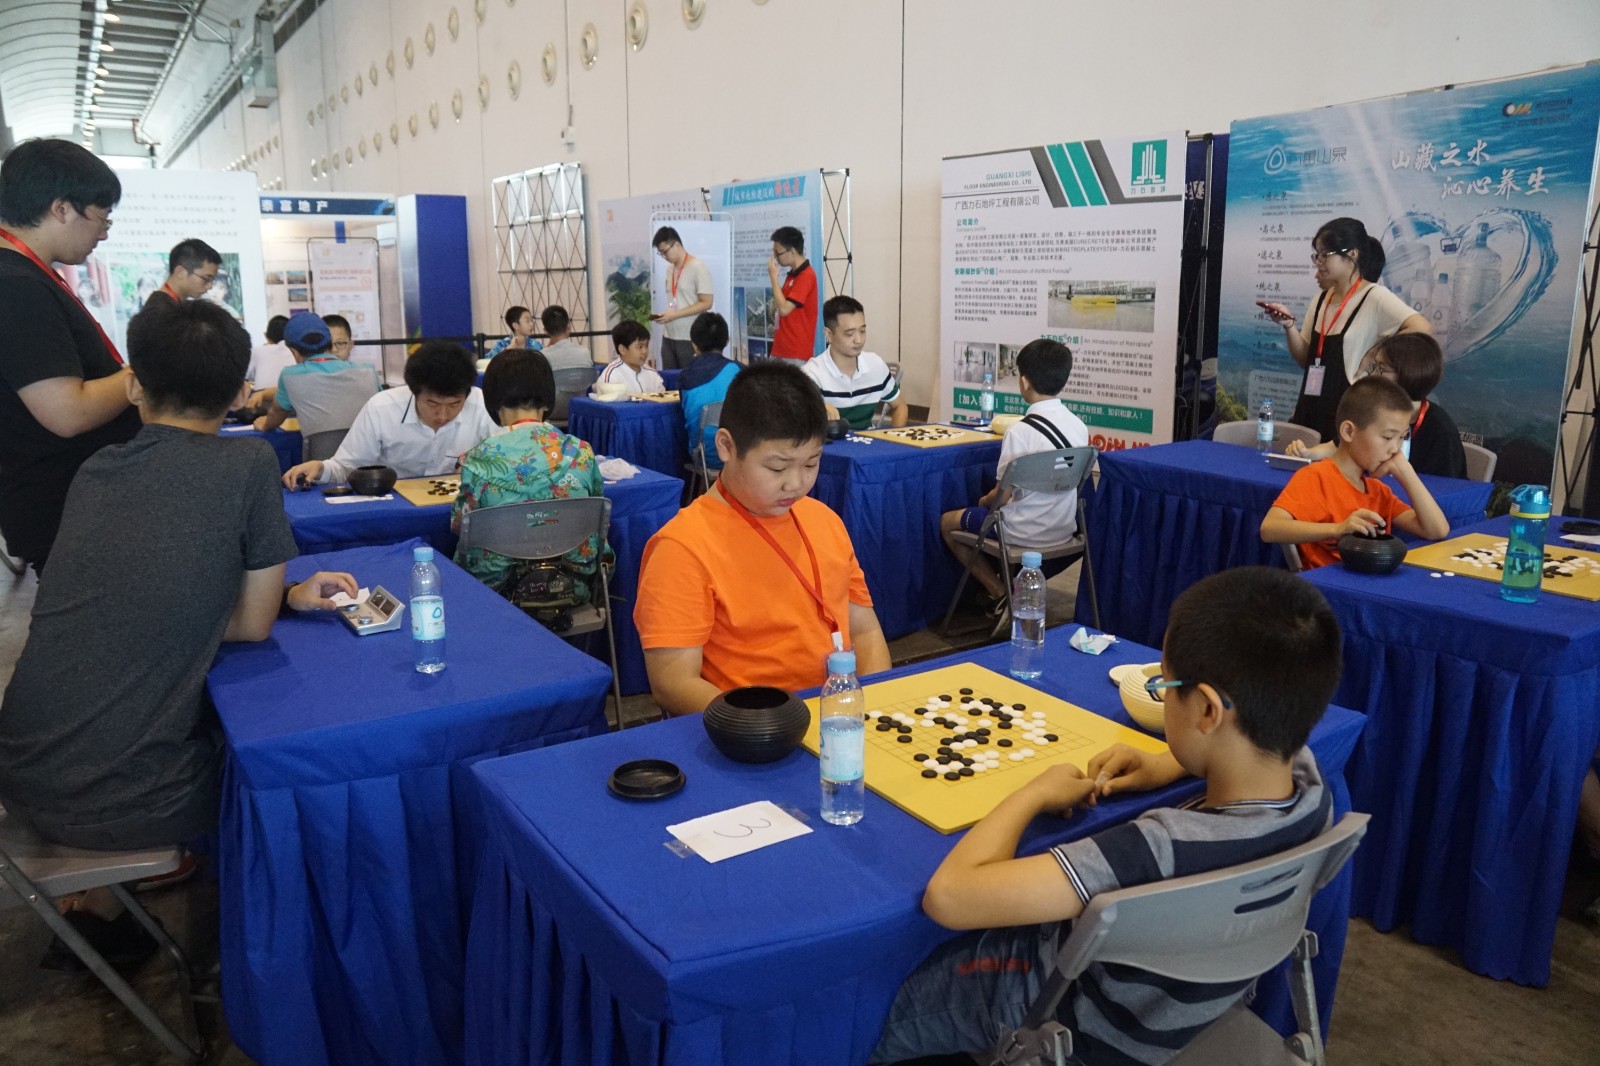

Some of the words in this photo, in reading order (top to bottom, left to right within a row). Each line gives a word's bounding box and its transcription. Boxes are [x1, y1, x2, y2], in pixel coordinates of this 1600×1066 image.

[1391, 139, 1490, 173] 山藏之水
[986, 171, 1014, 181] GUANGXI
[1015, 169, 1032, 179] LISHI
[1440, 166, 1549, 201] 沁心养生
[954, 194, 1040, 211] 广西力石地坪工程有限公司
[956, 217, 980, 227] 公司简介
